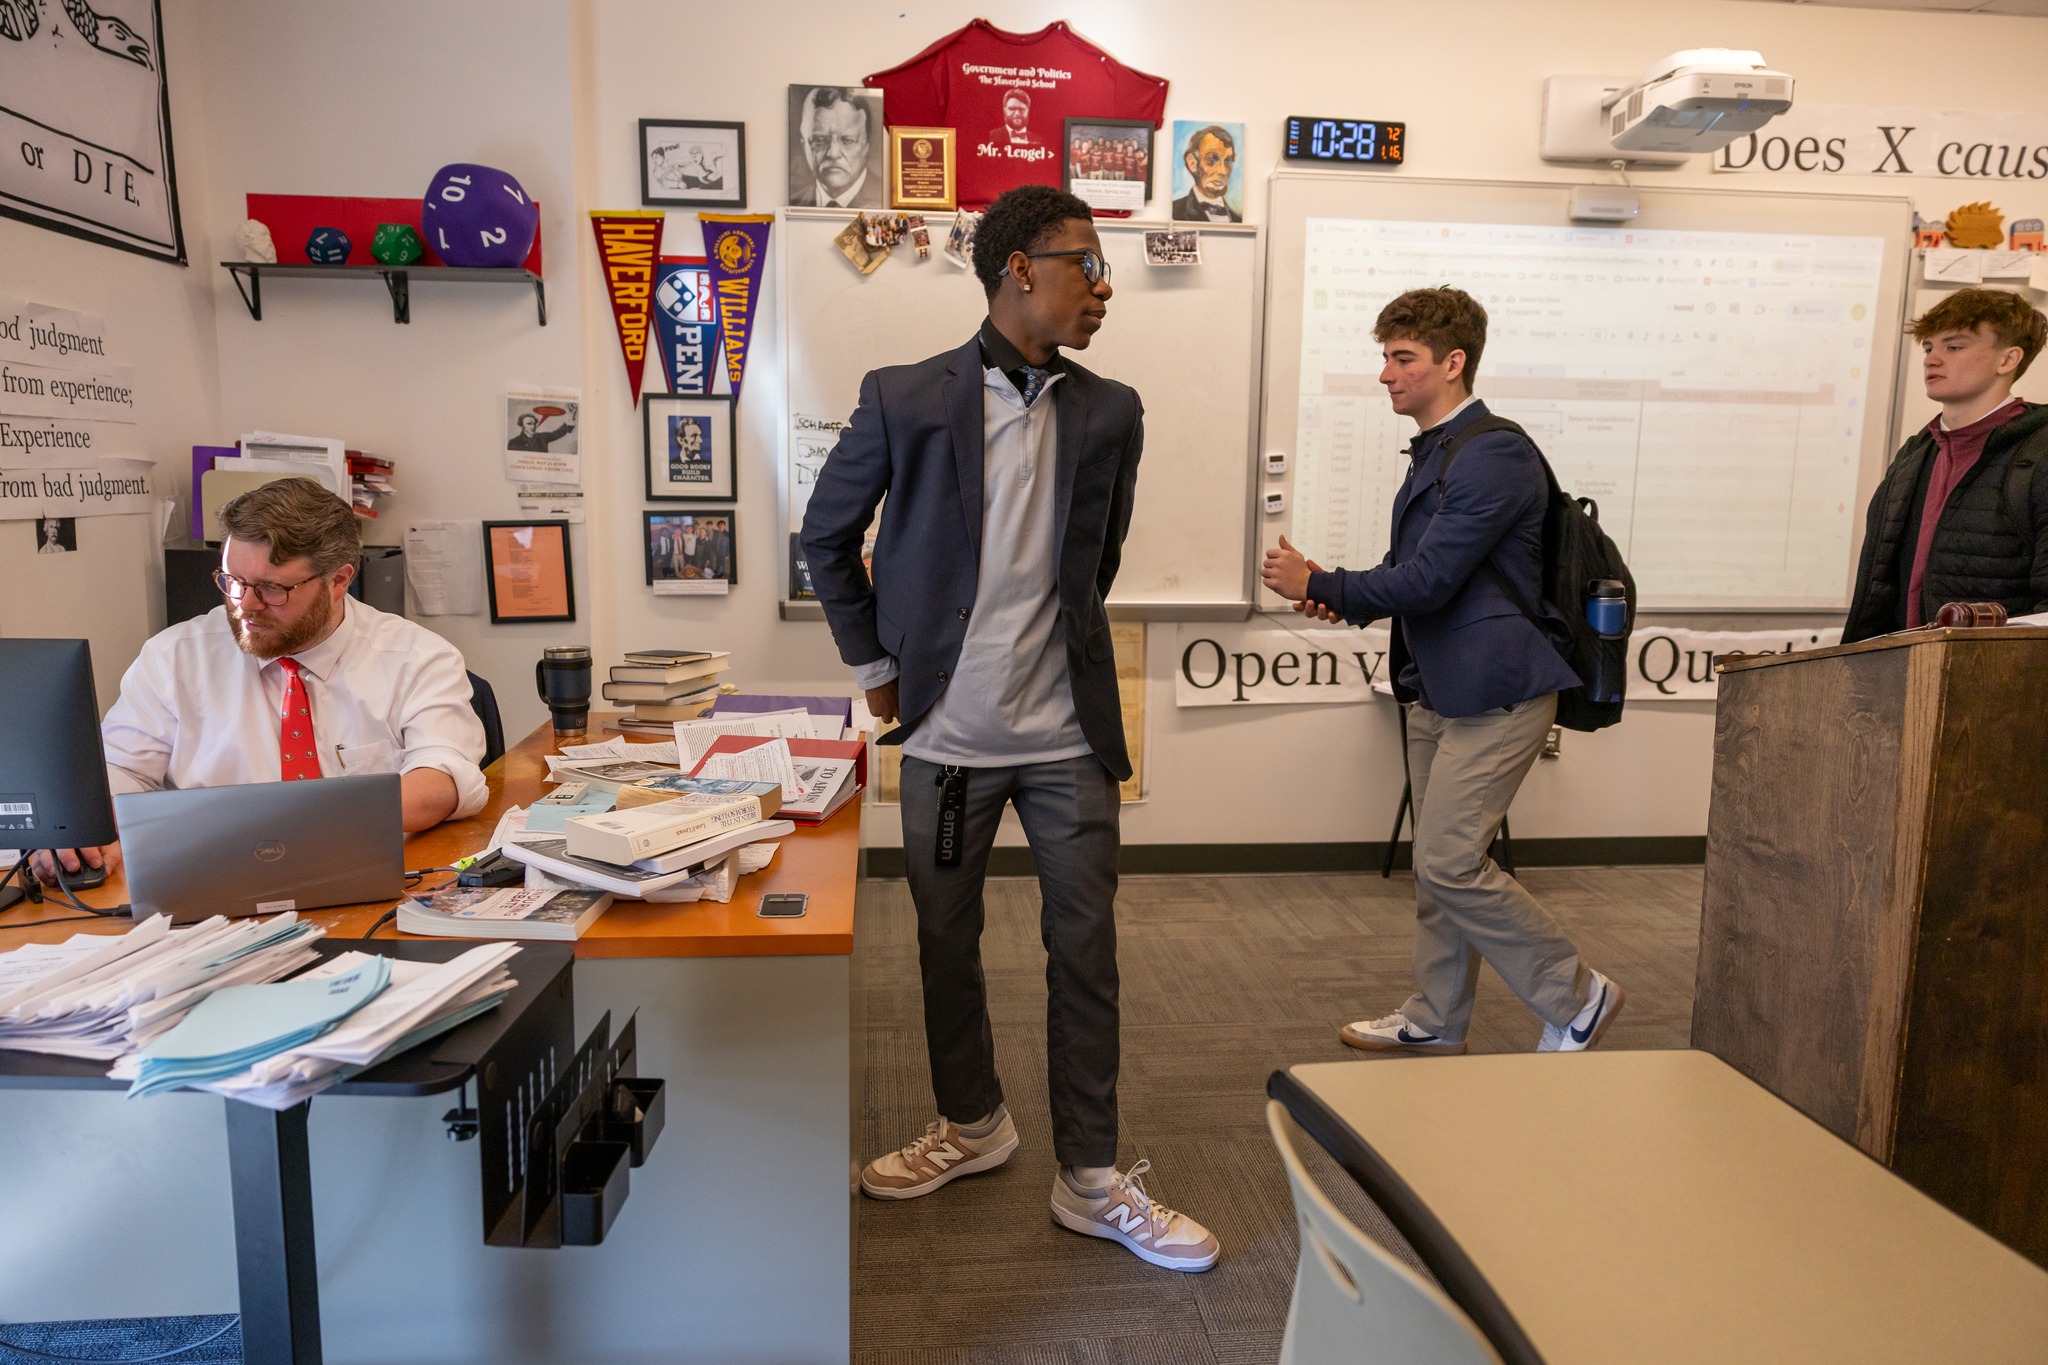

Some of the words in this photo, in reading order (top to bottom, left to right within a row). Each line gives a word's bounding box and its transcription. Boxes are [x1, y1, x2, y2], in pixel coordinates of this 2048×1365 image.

[962, 62, 1017, 77] Government
[1018, 66, 1036, 78] and
[1037, 67, 1072, 80] Politics
[978, 74, 992, 84] The
[993, 76, 1030, 88] Haverford
[1032, 78, 1056, 89] School
[977, 143, 1002, 158] Mr.
[1004, 145, 1046, 162] Lengel
[1311, 120, 1376, 160] 10:28
[1720, 131, 1846, 172] Does
[1872, 126, 1916, 174] X
[20, 142, 44, 170] or
[441, 174, 472, 202] 10
[480, 227, 506, 248] 2
[600, 224, 656, 361] HAVERFORD
[29, 319, 105, 356] judgment
[717, 278, 750, 382] WILLIAMS
[2, 366, 44, 396] from
[50, 377, 133, 408] experience;
[0, 422, 91, 454] Experience
[0, 474, 38, 498] rom
[42, 472, 74, 498] bad
[79, 472, 150, 502] judgment.
[1182, 638, 1341, 702] Open
[820, 767, 838, 778] TO
[499, 889, 529, 908] EBATE
